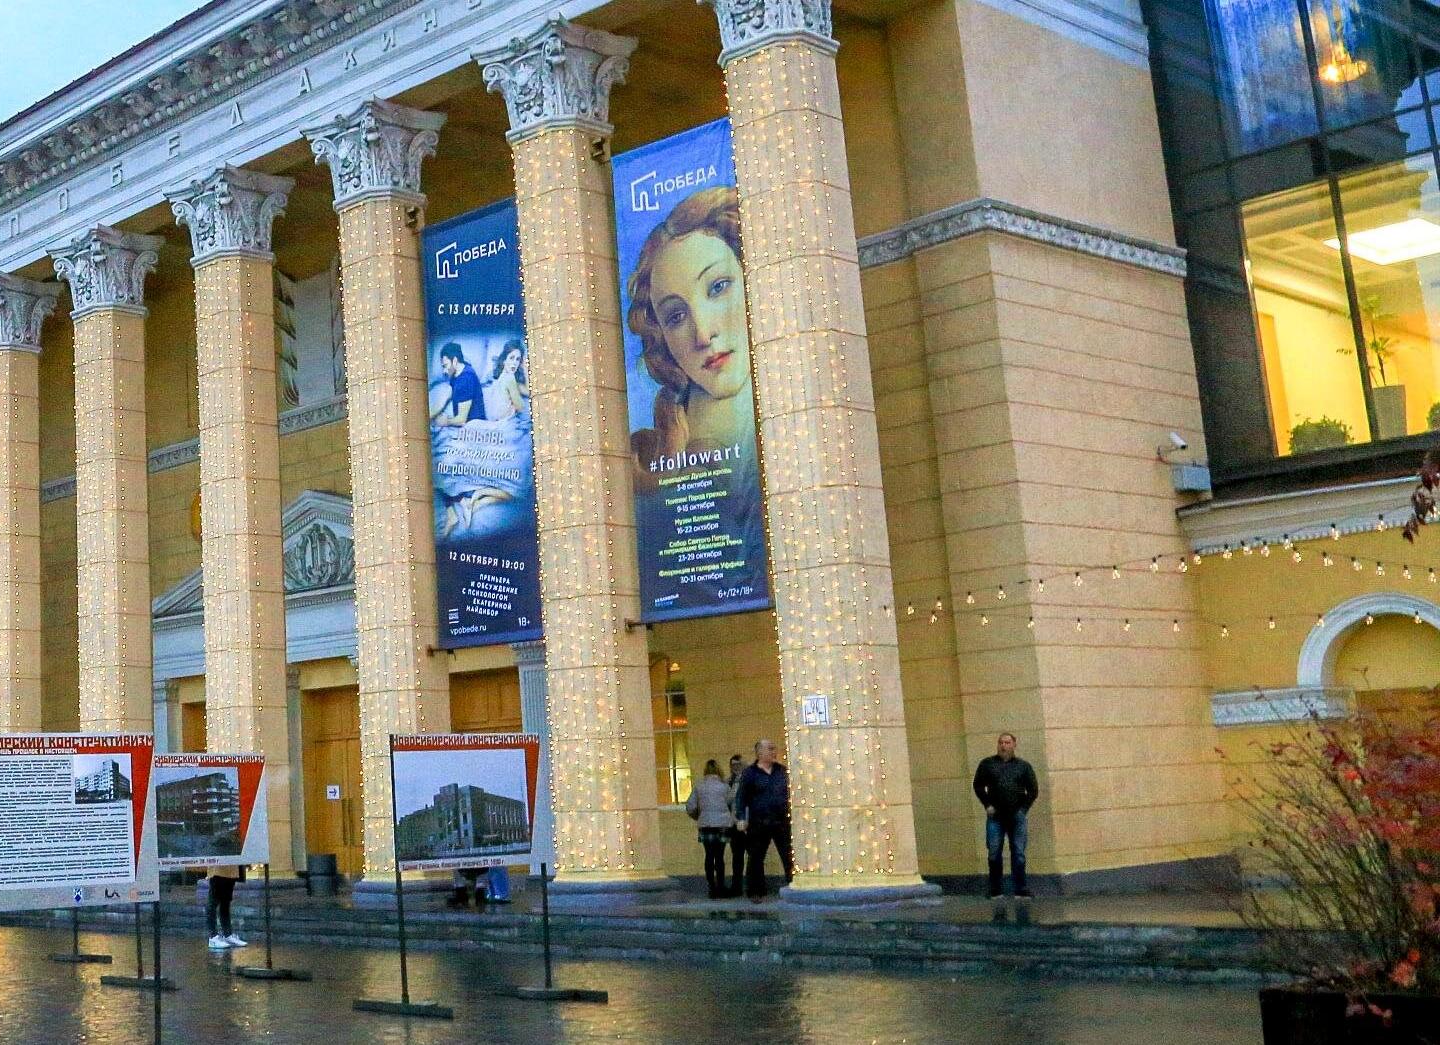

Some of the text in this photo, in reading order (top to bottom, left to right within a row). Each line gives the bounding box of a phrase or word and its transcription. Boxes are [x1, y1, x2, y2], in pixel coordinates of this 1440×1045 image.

[654, 164, 717, 196] ПОБЕДА
[454, 237, 506, 266] ПОБЕДА
[438, 304, 515, 315] С 13 ОКТЯБРЯ
[649, 443, 741, 472] #followart
[687, 480, 713, 490] октября
[689, 501, 715, 511] октября
[693, 522, 719, 532] октября
[449, 551, 525, 571] 12 ОКТЯБРЯ 19:00
[696, 550, 722, 560] октября
[479, 573, 510, 585] ПРЕМЬЕРА
[697, 572, 724, 581] октября
[476, 581, 519, 595] ОБСУЖДЕНИЕ
[467, 588, 509, 602] ПСИХОЛОГОМ
[473, 597, 512, 610] ЕКАТЕРИНОЙ
[466, 605, 499, 617] МАЙДИБОР
[518, 616, 531, 627] 18+
[450, 625, 487, 636] vpobede.ru
